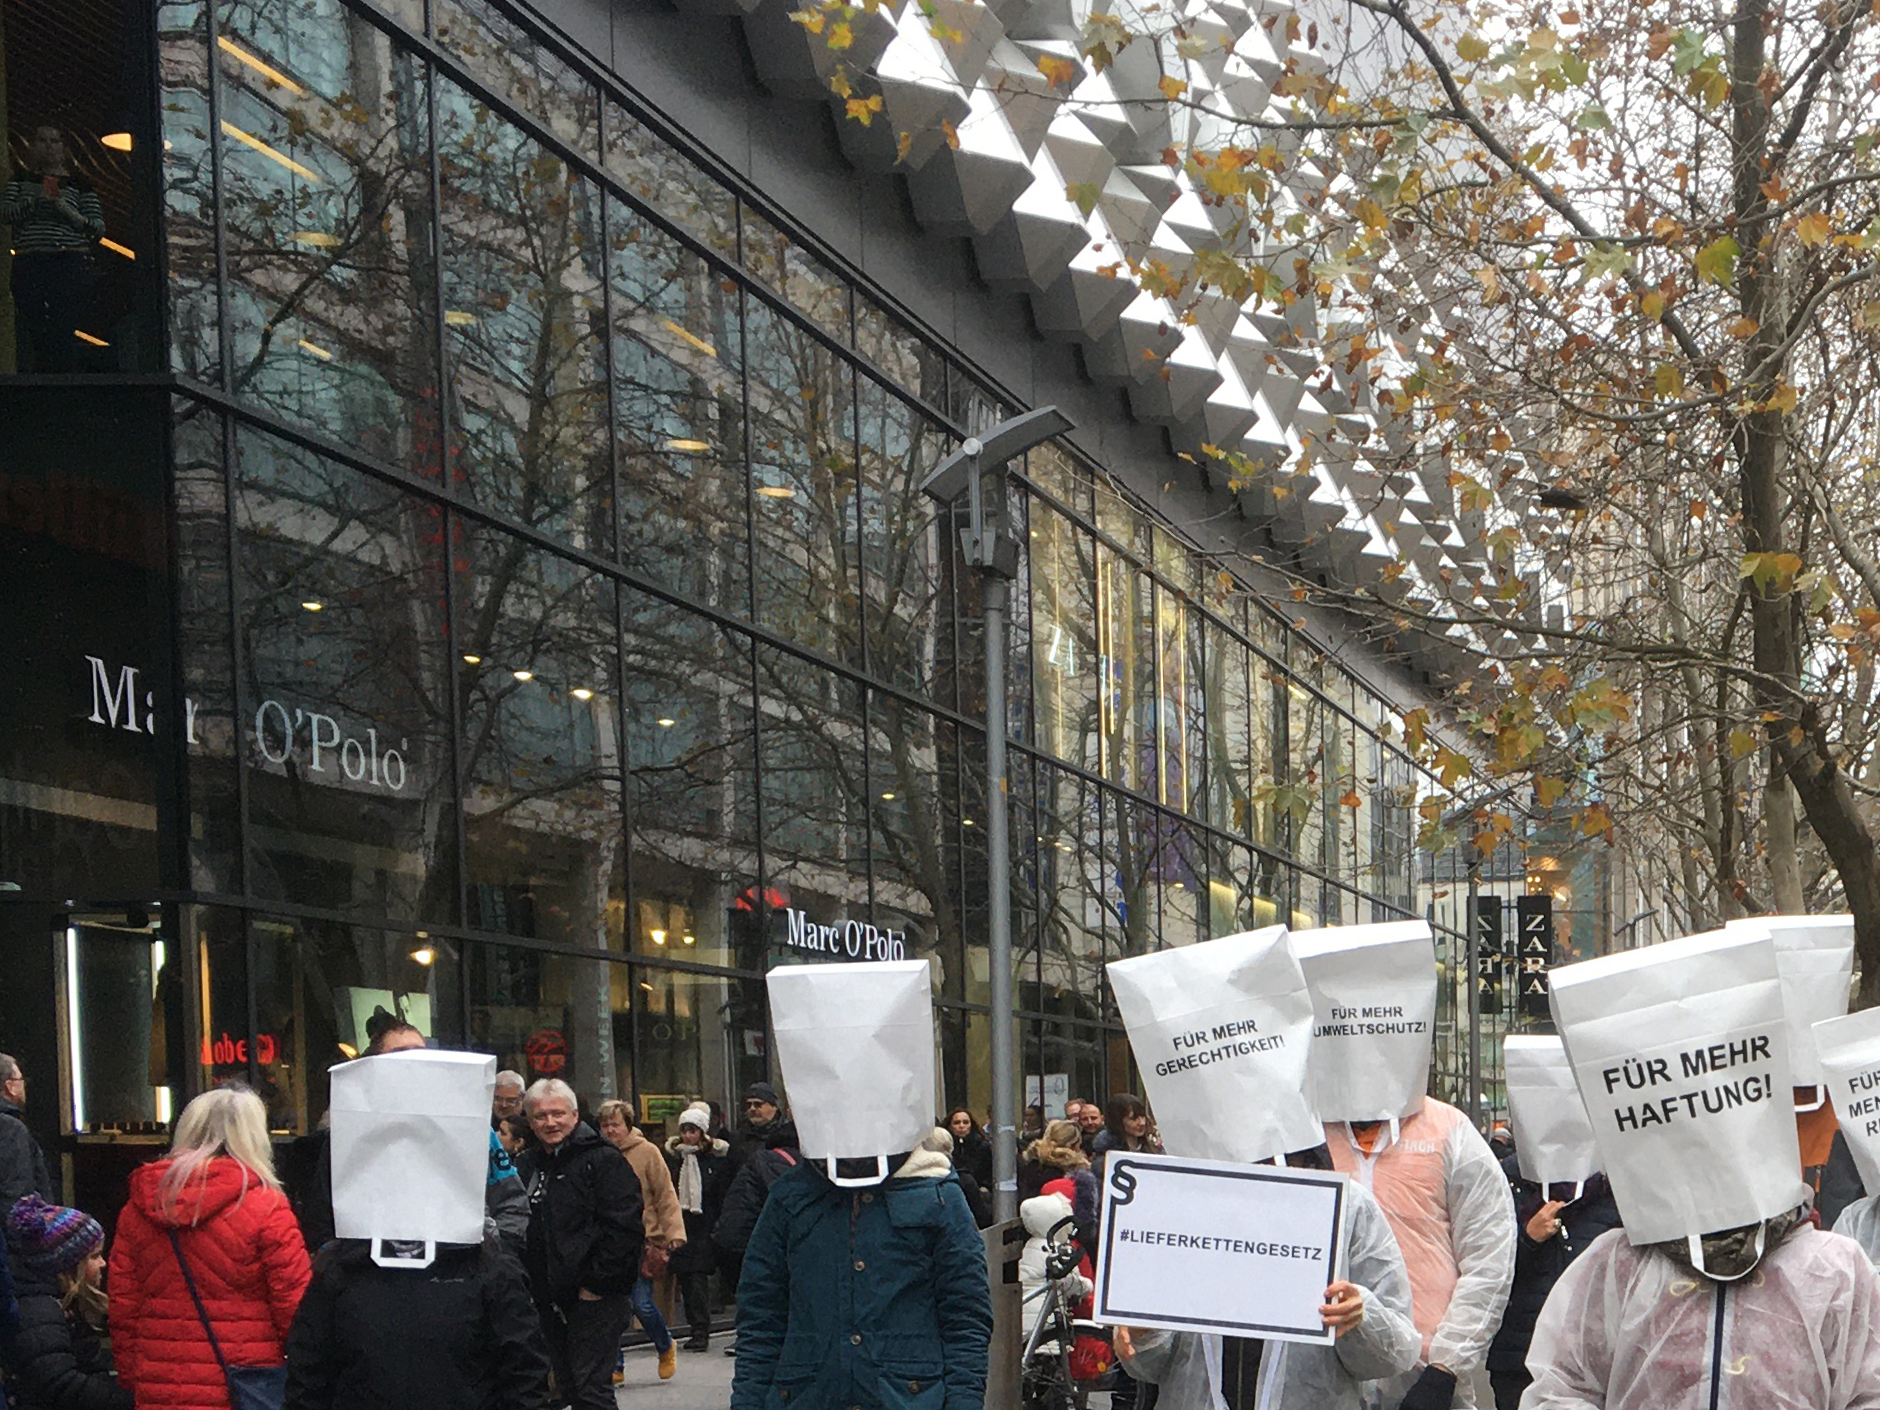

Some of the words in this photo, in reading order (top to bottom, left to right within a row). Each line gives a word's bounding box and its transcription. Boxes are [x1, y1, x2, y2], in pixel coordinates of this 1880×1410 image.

[255, 700, 406, 790] O'Polo
[787, 907, 839, 954] Marc
[844, 919, 906, 961] O'Polo
[1523, 914, 1548, 995] ZARA
[1173, 1030, 1209, 1051] FÜR
[1212, 1019, 1258, 1041] MEHR
[1313, 1021, 1427, 1037] UMWELTSCHUTZ!
[1331, 1005, 1358, 1020] FÜR
[1361, 1006, 1404, 1019] MEHR
[1155, 1035, 1286, 1077] GERECHTIGKEIT!
[1603, 1057, 1672, 1095] FÜR
[1680, 1035, 1772, 1078] MEHR
[1614, 1073, 1772, 1132] HAFTUNG!
[1120, 1229, 1322, 1261] #LIEFERKETTENGESETZ
